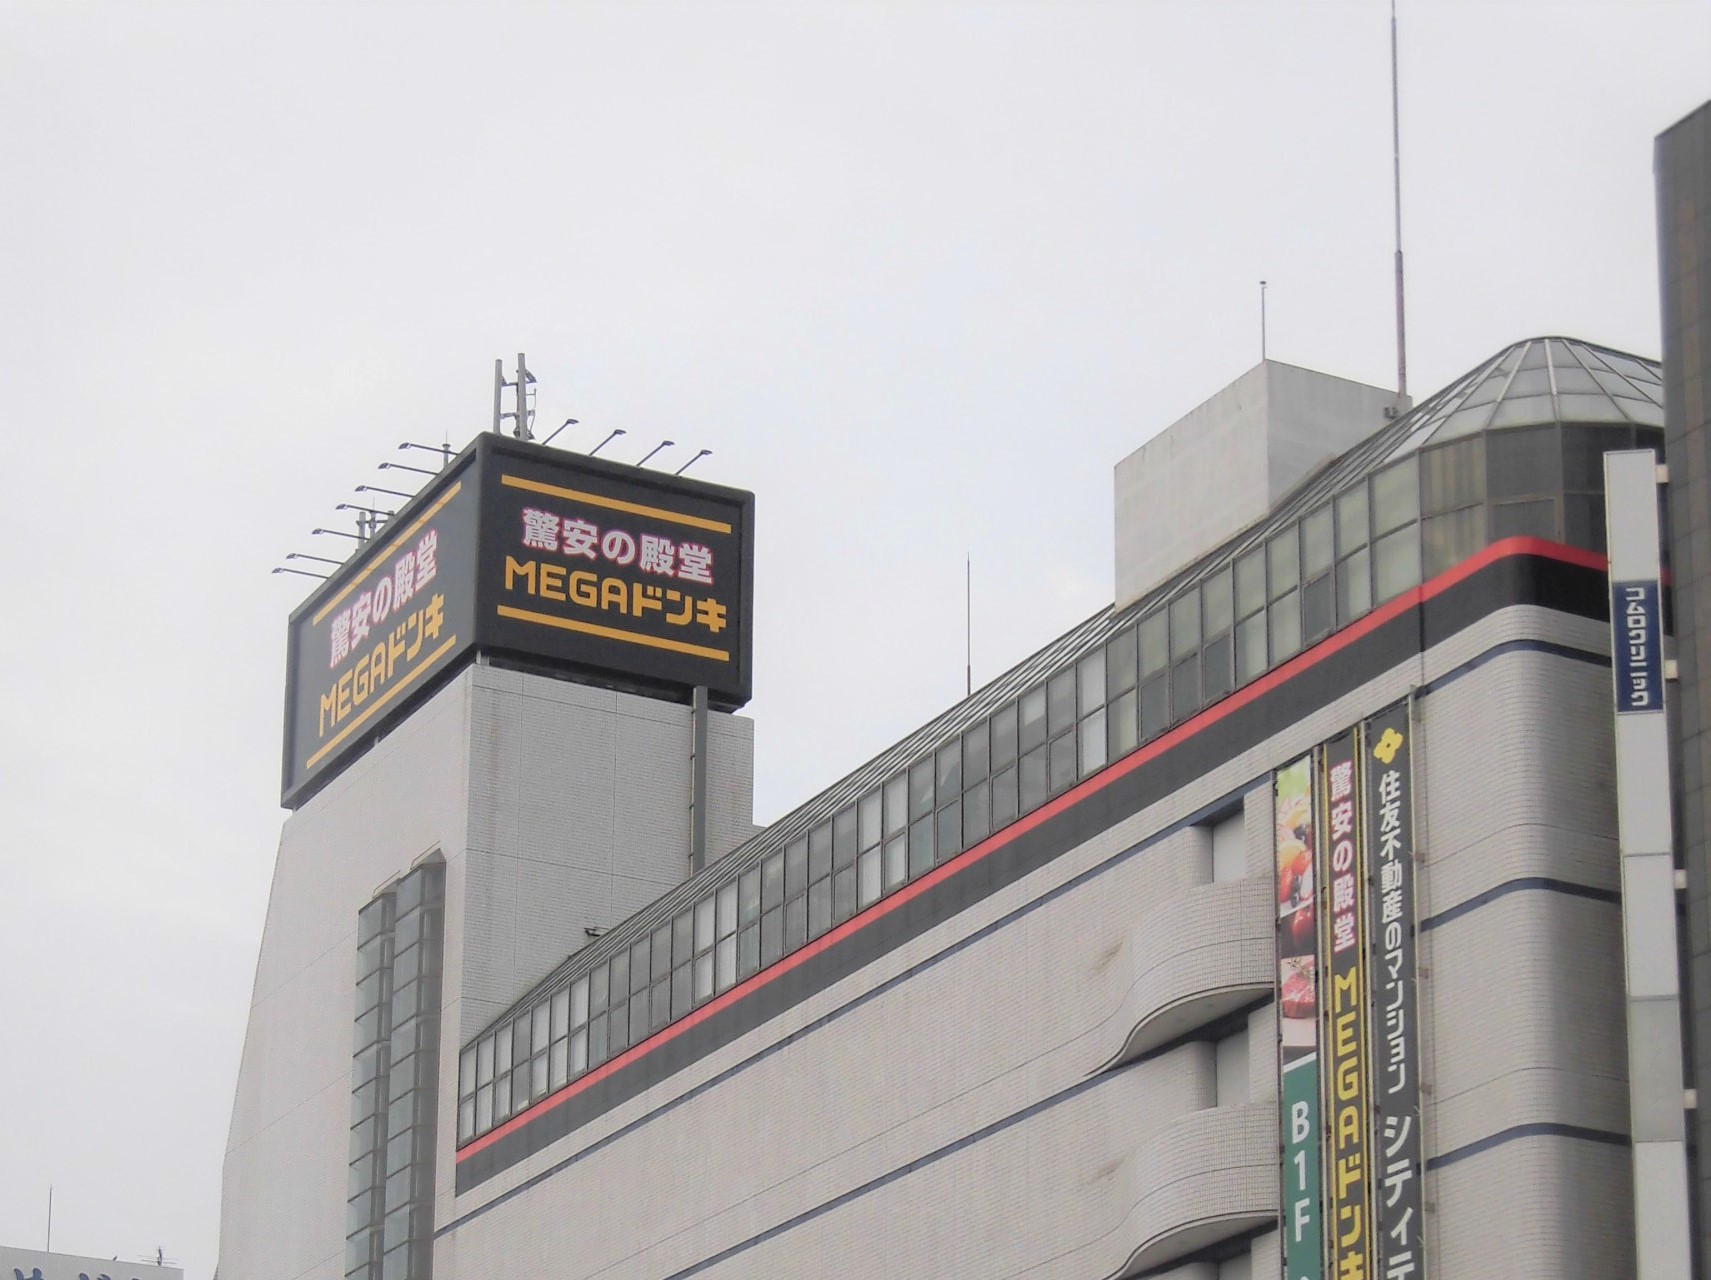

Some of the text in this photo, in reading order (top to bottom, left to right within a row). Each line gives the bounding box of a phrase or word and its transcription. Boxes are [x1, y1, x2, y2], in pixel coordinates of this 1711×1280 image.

[329, 529, 439, 668] 驚安の殿堂
[504, 555, 728, 634] MEGAドンキ
[521, 506, 715, 585] 驚安の殿堂
[319, 592, 446, 738] MEGAドンキ
[1329, 760, 1356, 954] 驚安の殿堂
[1377, 770, 1407, 1096] 住友不動産のマンション
[1291, 1100, 1312, 1243] B1F
